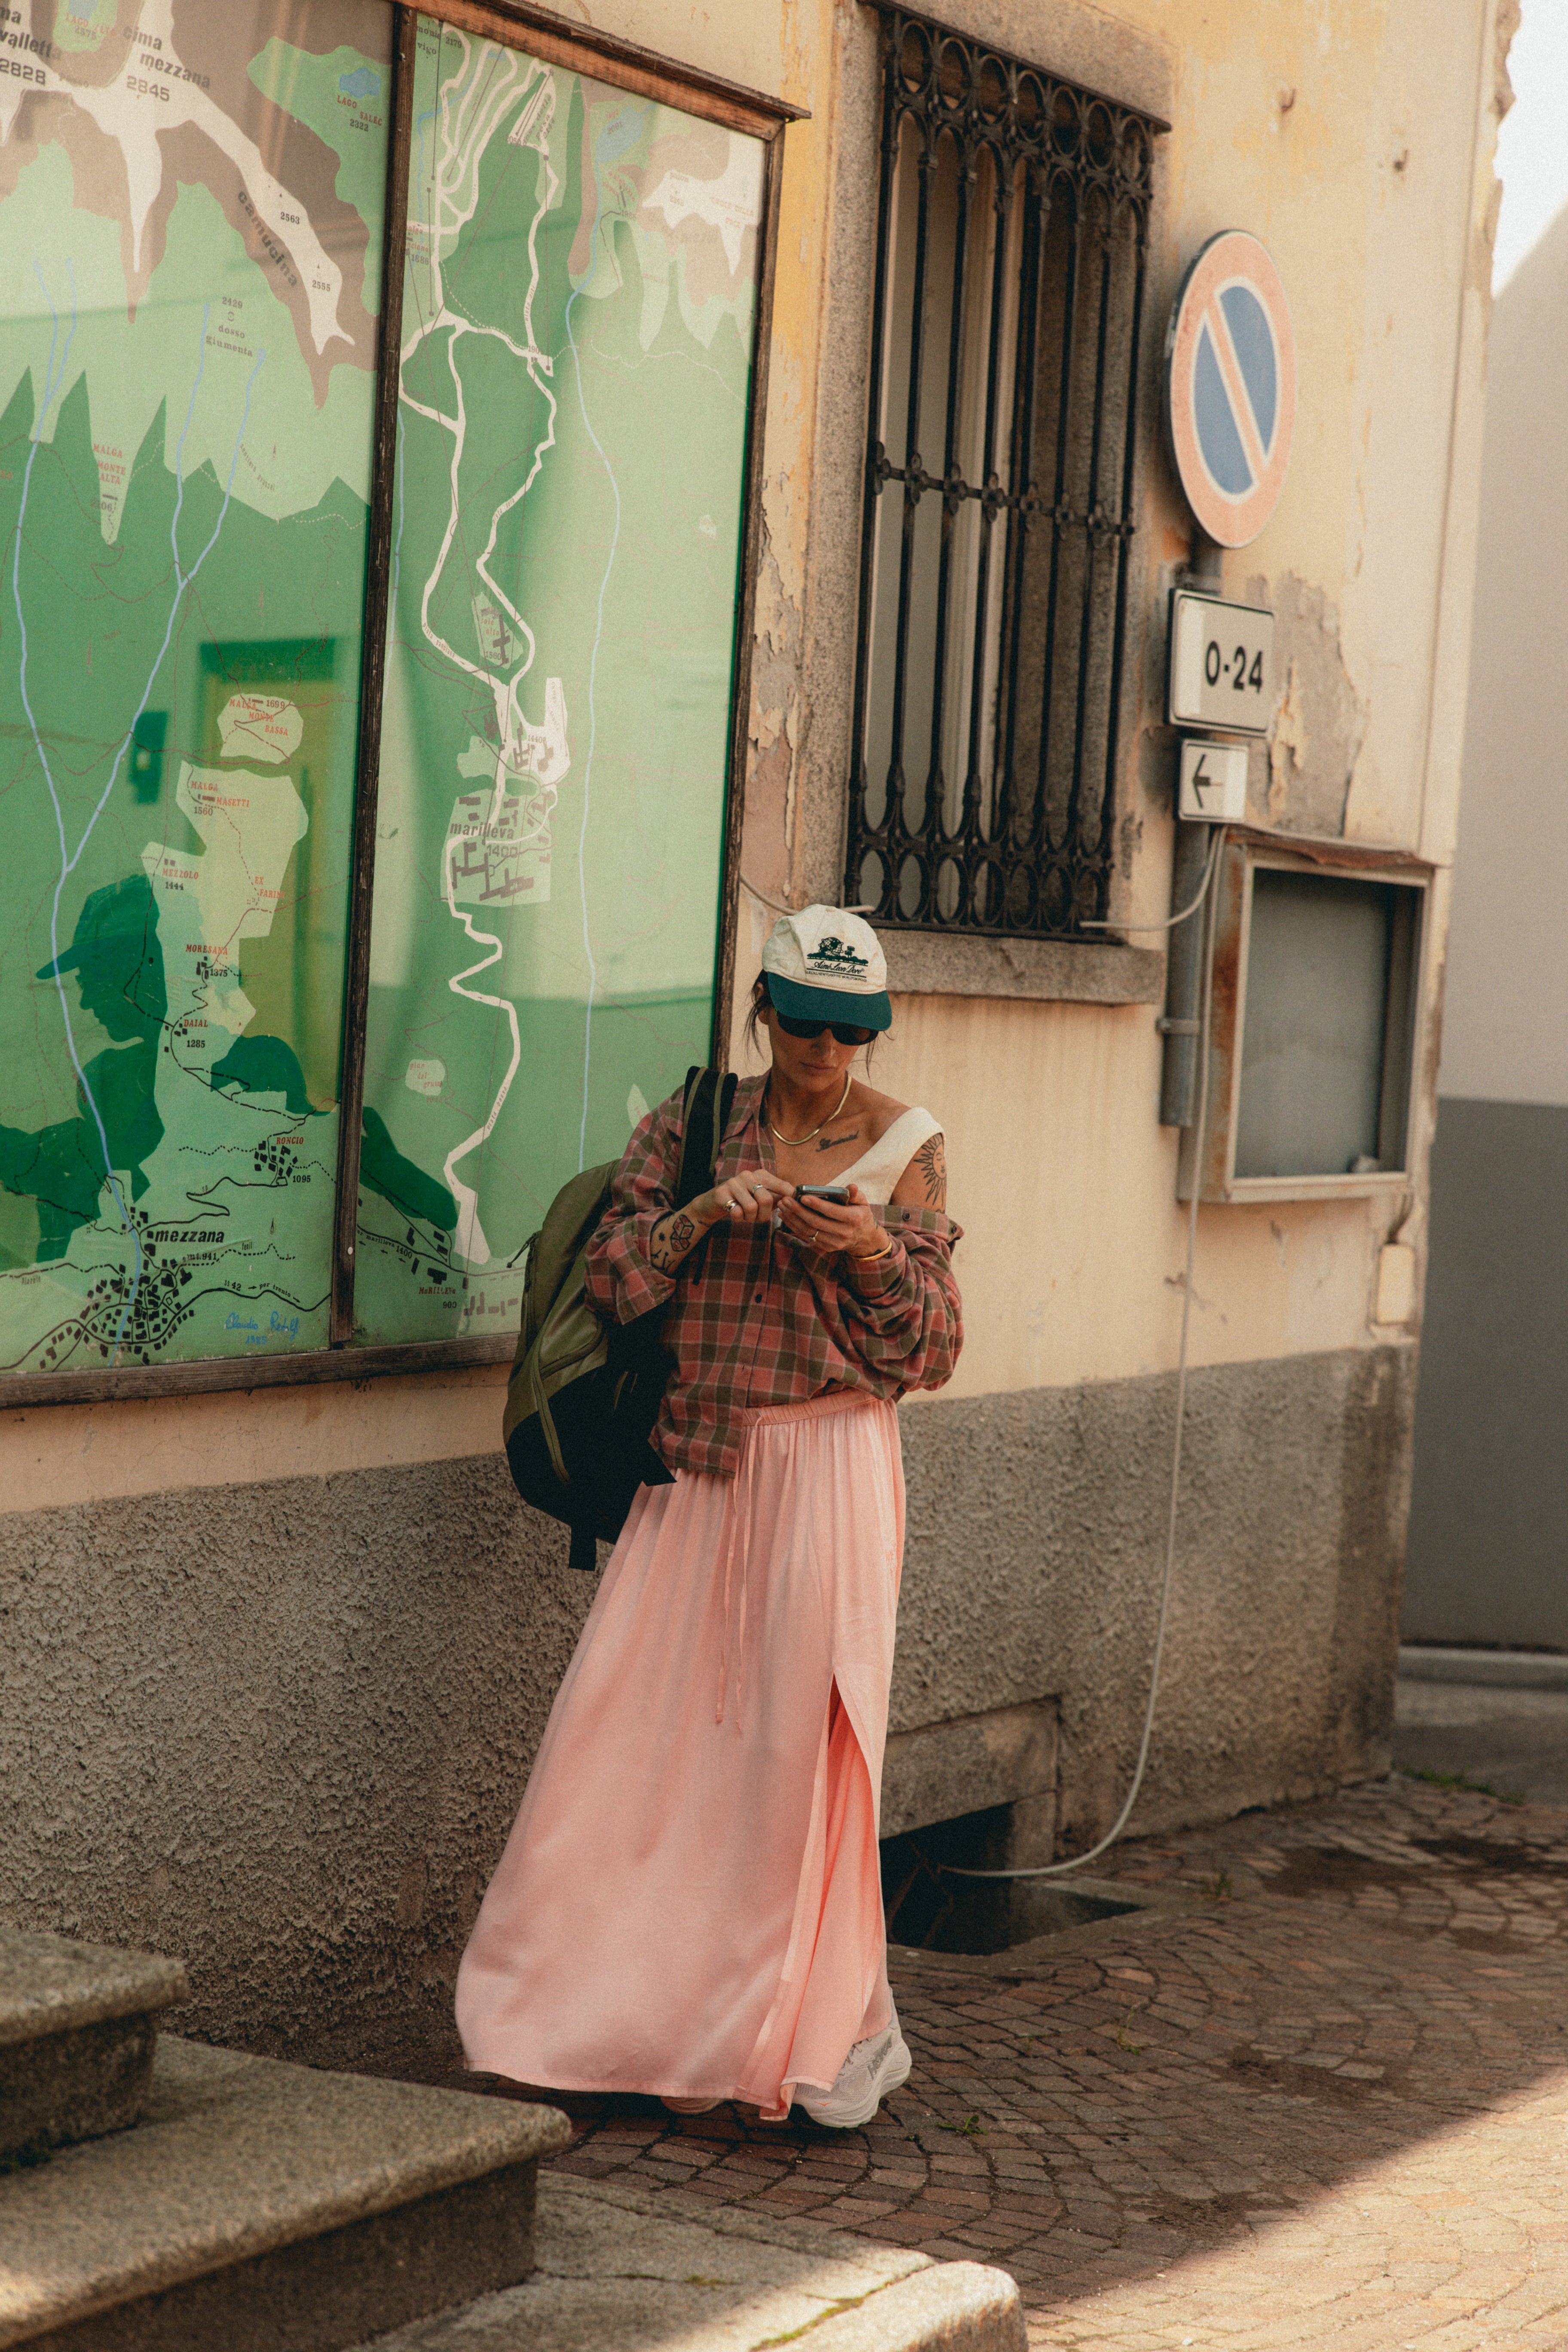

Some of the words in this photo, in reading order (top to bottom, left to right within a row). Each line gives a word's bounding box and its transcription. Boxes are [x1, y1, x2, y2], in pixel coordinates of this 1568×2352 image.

[123, 26, 162, 51] cima
[445, 36, 462, 48] 2179
[417, 42, 437, 55] vigo
[140, 53, 211, 89] mezzana
[126, 75, 170, 102] 2845
[337, 95, 357, 109] LAGO
[359, 111, 382, 126] SALEC
[349, 119, 369, 132] 2322
[280, 211, 300, 225] 2563
[408, 226, 423, 236] alga
[312, 279, 331, 292] 2555
[222, 297, 243, 309] 2429
[218, 325, 245, 339] dosso
[205, 335, 254, 357] giumenta
[93, 443, 122, 459] MALGA
[98, 460, 126, 475] MONTE
[99, 472, 120, 484] ALTA
[229, 698, 257, 710] MALGA
[266, 700, 285, 709] 1699
[265, 725, 288, 736] BASSA
[191, 781, 218, 792] MALGA
[216, 796, 250, 808] MASETTI
[194, 806, 213, 816] 1560
[450, 822, 514, 839] marilleva
[487, 844, 518, 858] 1400
[162, 868, 199, 880] MEZZOLO
[165, 882, 184, 891] 1444
[254, 876, 264, 885] EX
[260, 888, 285, 899] FARINI
[186, 944, 228, 956] MORESANA
[210, 968, 228, 977] 1375
[184, 1019, 208, 1027] DAIAL
[187, 1039, 205, 1048] 1285
[276, 1136, 304, 1145] RONCIO
[293, 1175, 311, 1183] 1095
[155, 1230, 225, 1243] mezzana
[366, 1235, 395, 1248] marilleva
[396, 1246, 413, 1259] 1400
[232, 1281, 242, 1292] 42
[273, 1284, 291, 1297] trento
